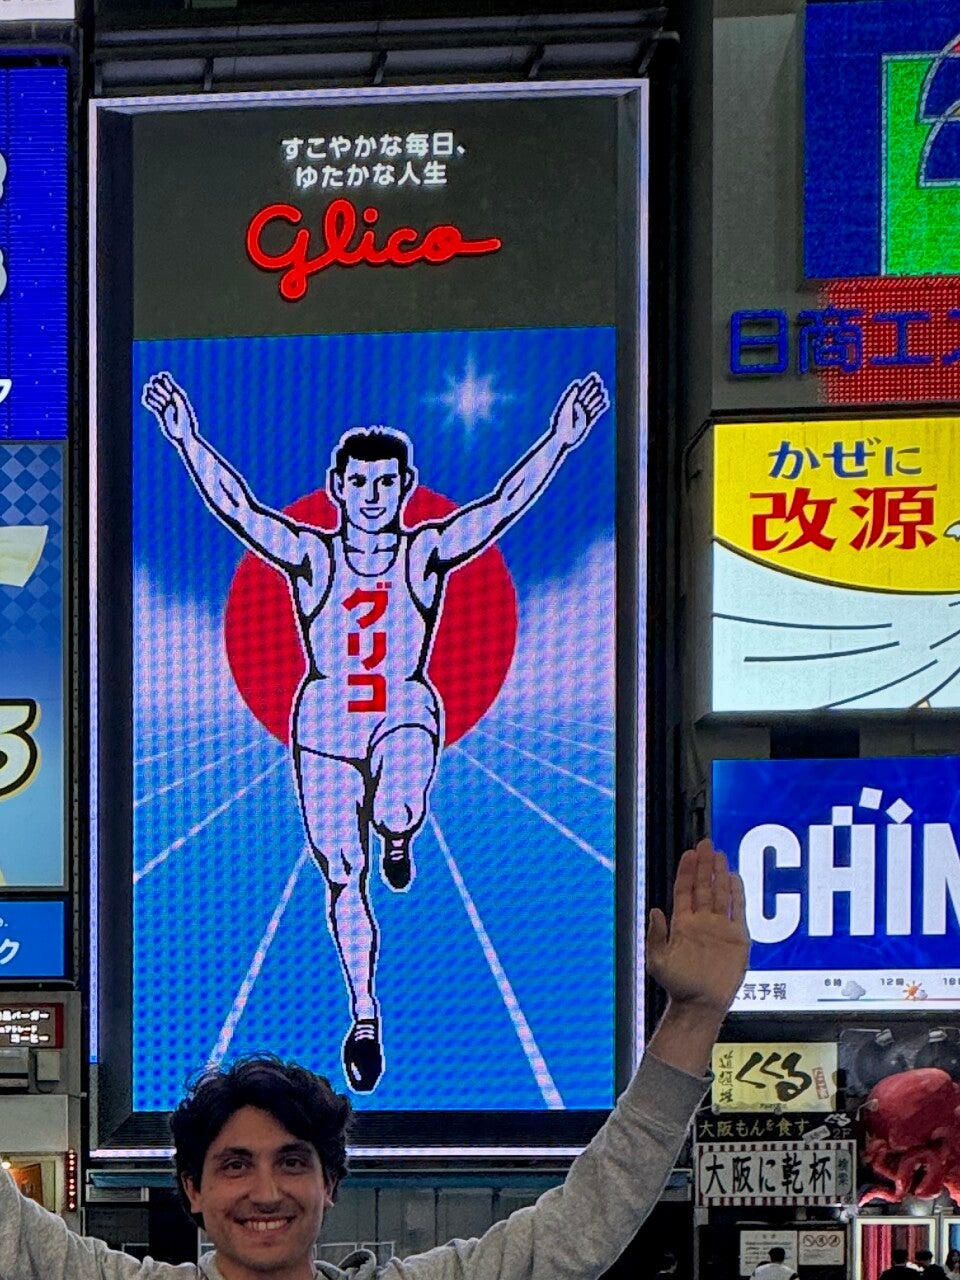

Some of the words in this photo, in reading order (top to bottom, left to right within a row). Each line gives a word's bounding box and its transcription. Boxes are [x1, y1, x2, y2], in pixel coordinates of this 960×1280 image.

[281, 131, 466, 161] すこやかな毎日、
[295, 161, 448, 189] ゆたかな人生
[246, 197, 502, 300] Glico
[767, 436, 923, 480] かぜに
[749, 483, 939, 554] 改源
[341, 582, 393, 713] グリコ
[735, 1051, 813, 1102] くくる
[705, 1152, 832, 1196] 大阪に乾杯
